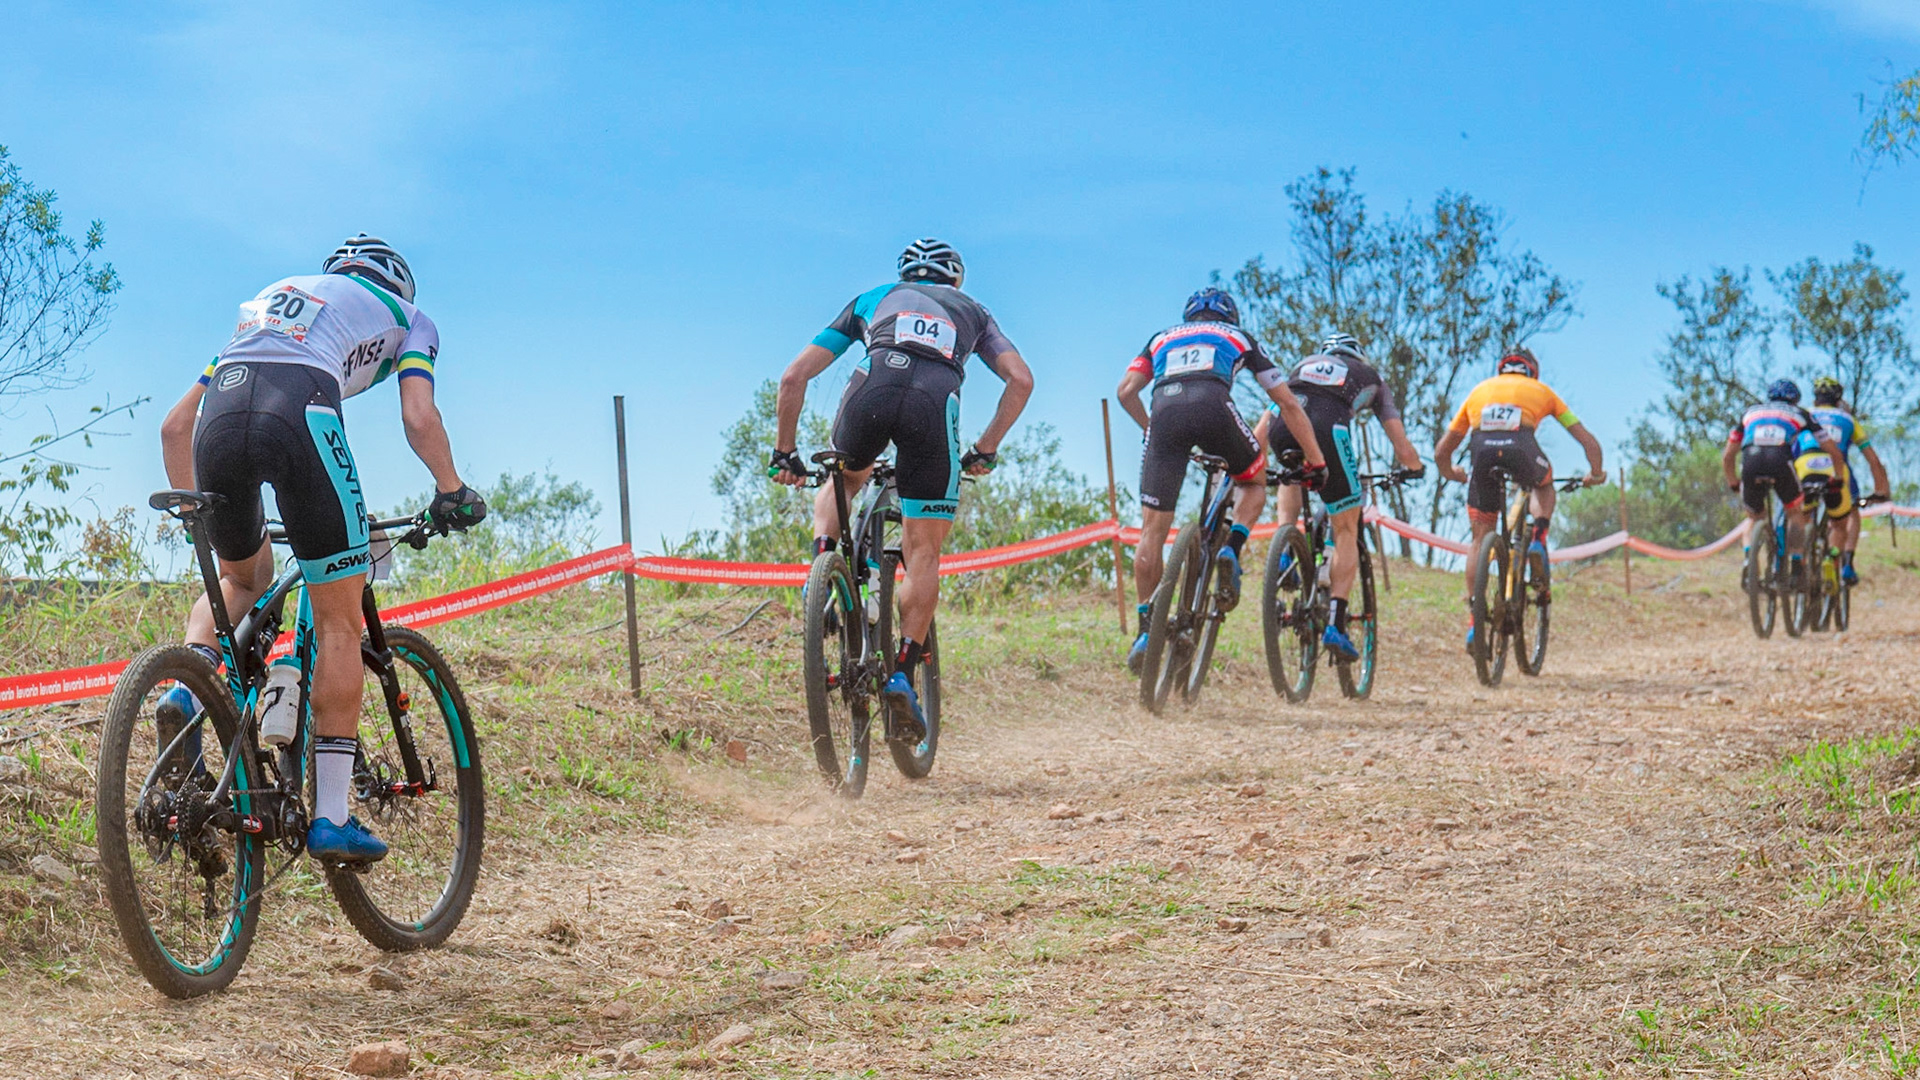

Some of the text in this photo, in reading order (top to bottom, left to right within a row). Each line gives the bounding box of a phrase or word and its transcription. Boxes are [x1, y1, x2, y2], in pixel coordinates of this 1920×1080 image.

[266, 292, 305, 320] 20
[914, 319, 940, 338] 04
[1181, 349, 1200, 365] 12
[1491, 408, 1514, 420] 127
